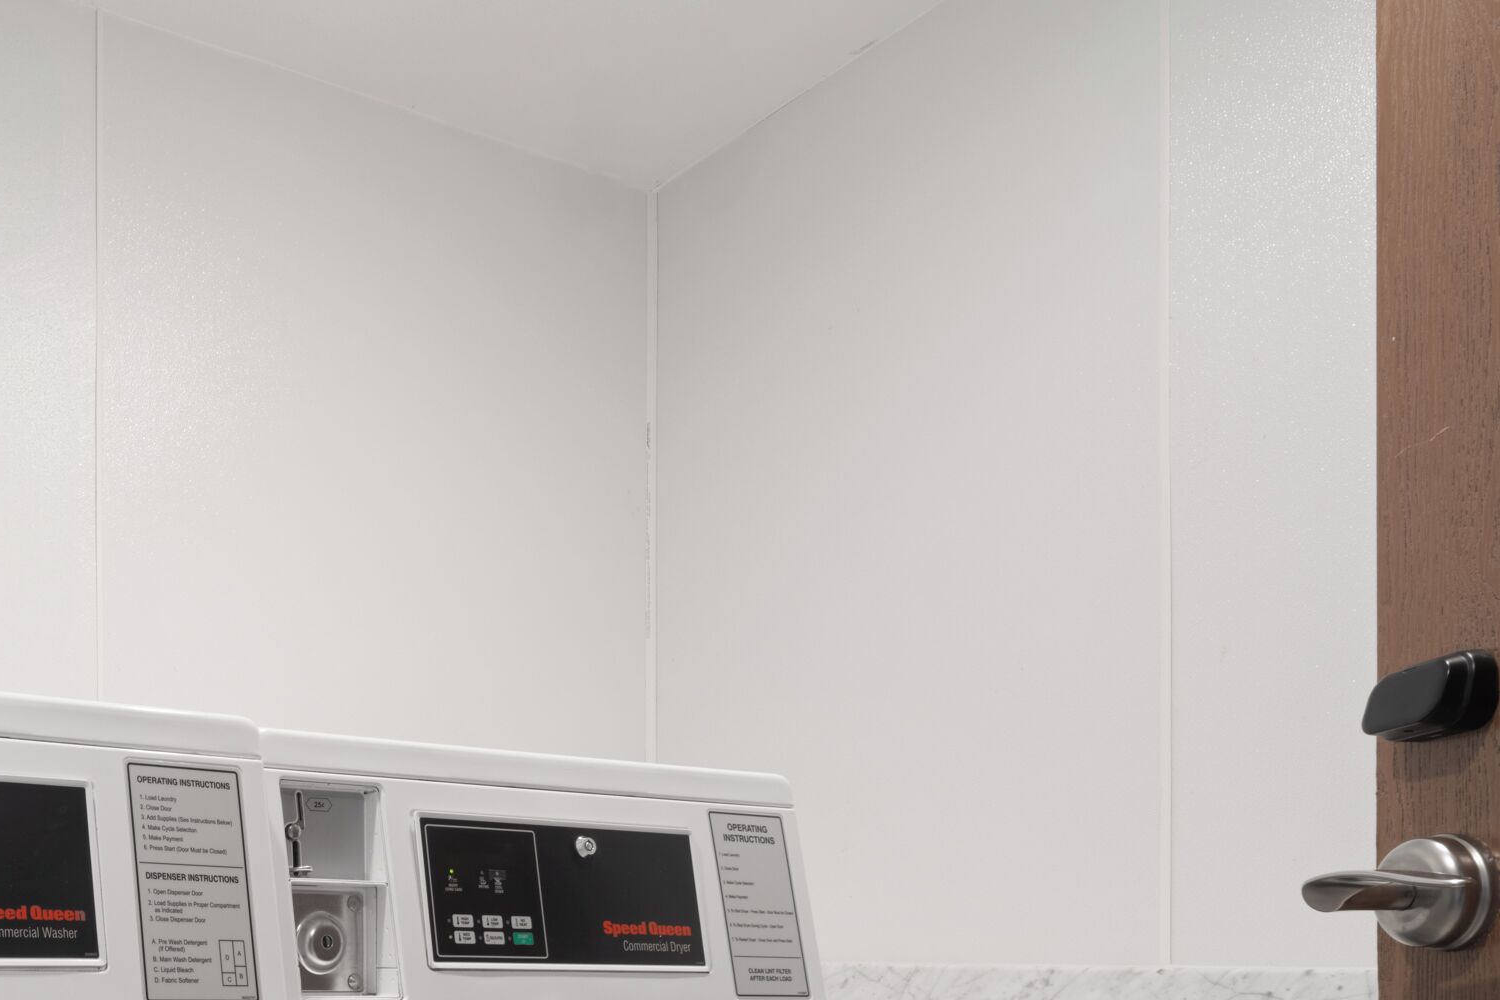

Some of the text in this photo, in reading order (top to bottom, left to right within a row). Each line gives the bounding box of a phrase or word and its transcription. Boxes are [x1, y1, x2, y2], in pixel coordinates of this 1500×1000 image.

[137, 776, 230, 790] OPERATING INSTRUCTIONS
[727, 823, 768, 833] OPERATING
[723, 834, 775, 844] INSTRUCTIONS
[146, 872, 239, 884] DISPENSER INSTRUCTIONS
[30, 905, 86, 921] Queen
[42, 926, 78, 939] Washer
[603, 920, 691, 937] Speed Queen
[624, 940, 690, 954] Commercial Dryer
